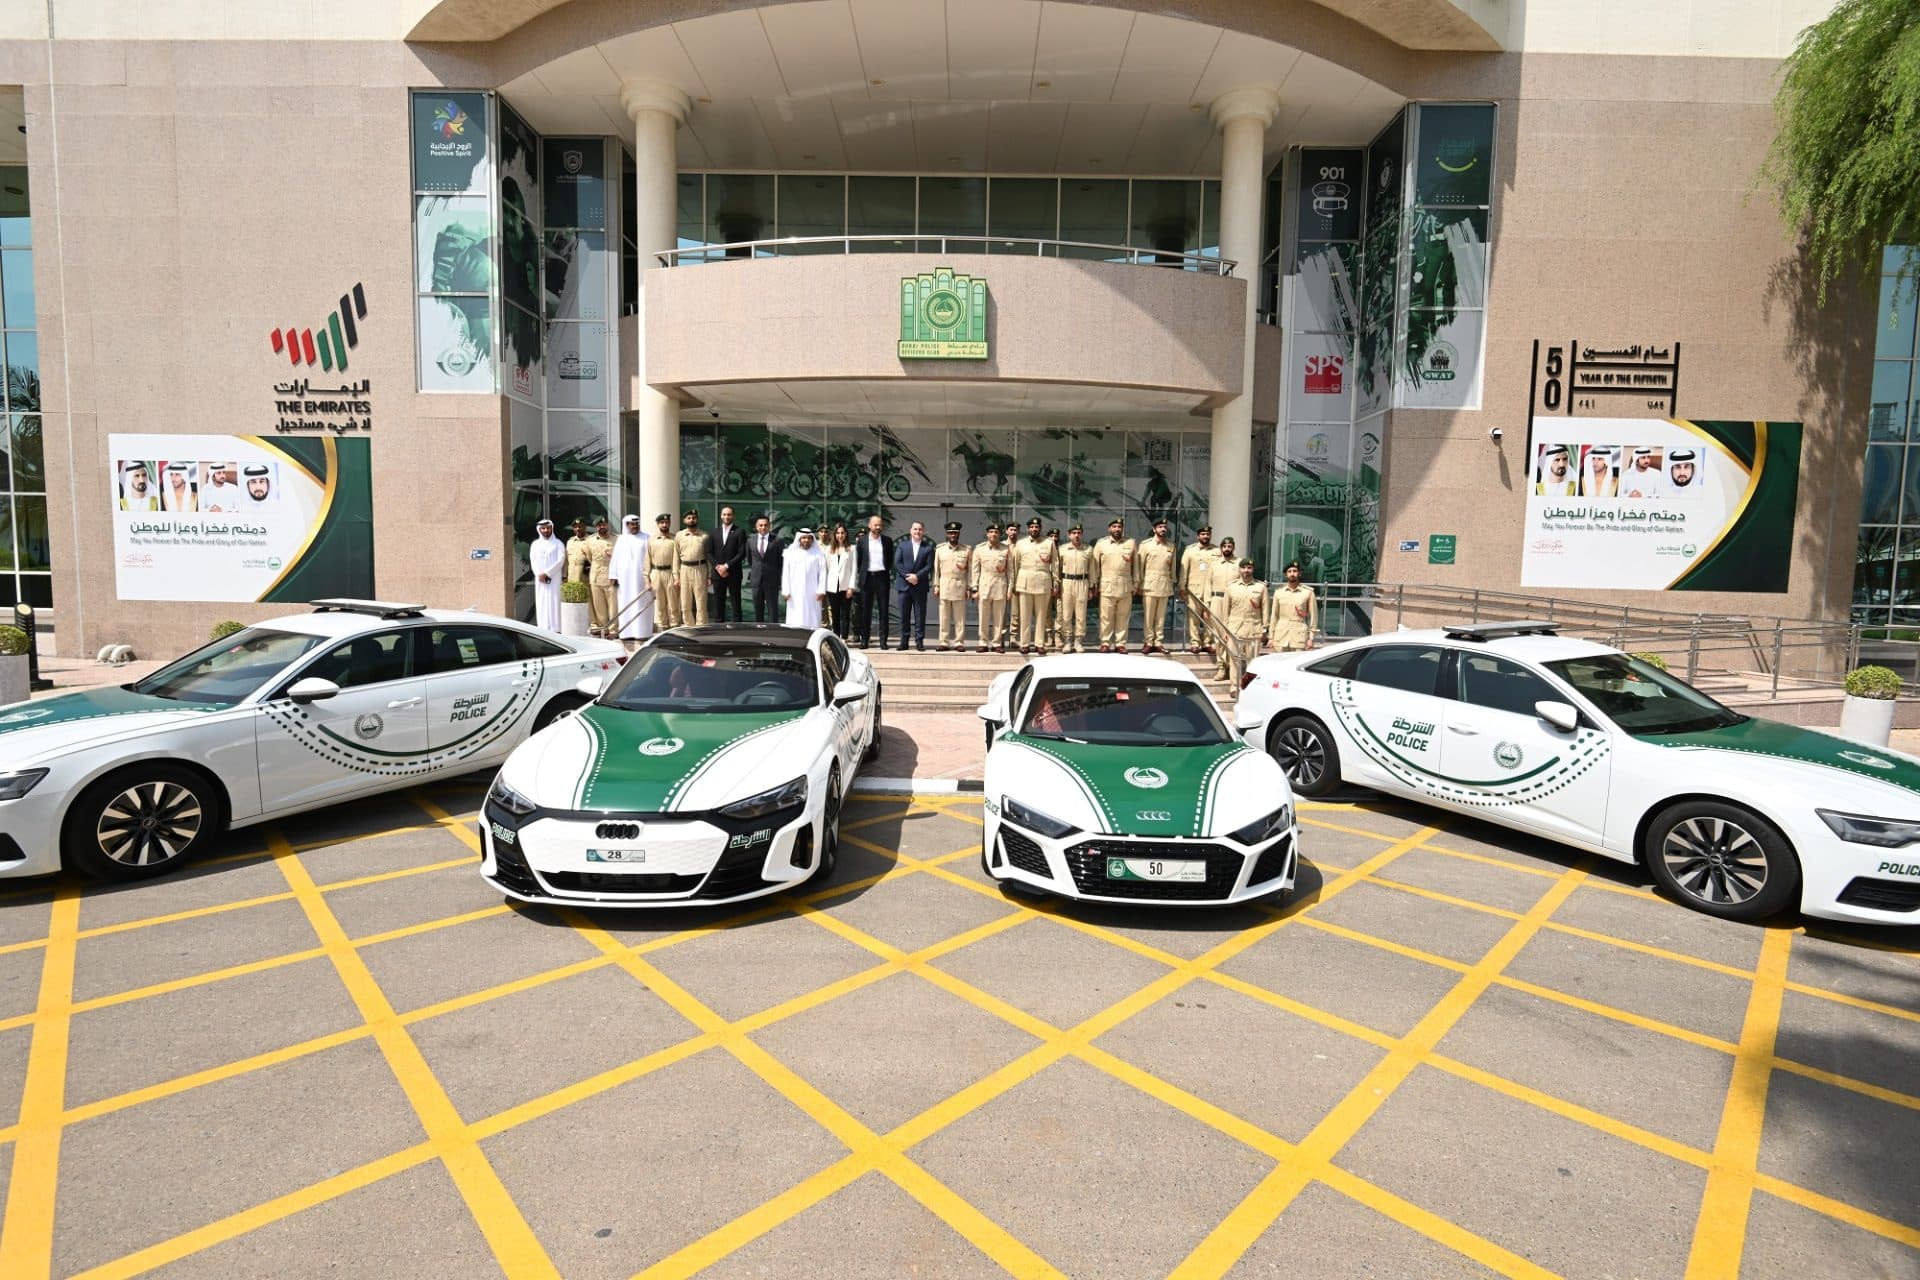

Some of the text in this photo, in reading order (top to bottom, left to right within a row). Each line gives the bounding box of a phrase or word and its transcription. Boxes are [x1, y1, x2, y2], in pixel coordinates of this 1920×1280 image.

[1320, 166, 1345, 180] 901
[1304, 355, 1343, 376] SPS
[1580, 374, 1668, 386] YEAR OF THE FIFTIETH
[275, 400, 372, 414] THE EMIRATES
[1647, 400, 1665, 411] UAE
[275, 416, 325, 433] مستحيل
[360, 416, 372, 430] لا
[1543, 506, 1587, 519] للوطن
[1648, 509, 1686, 522] دمتم
[129, 521, 171, 534] للوطن
[231, 523, 268, 535] دمتم
[453, 693, 490, 710] الشرطة
[450, 706, 487, 723] POLICE
[1392, 716, 1436, 736] الشرطة
[1386, 732, 1430, 752] POLICE
[491, 822, 516, 844] POLICE
[729, 829, 772, 849] الشرطة
[607, 850, 622, 859] 28
[1149, 862, 1163, 876] 50
[1877, 861, 1920, 877] POLIC
